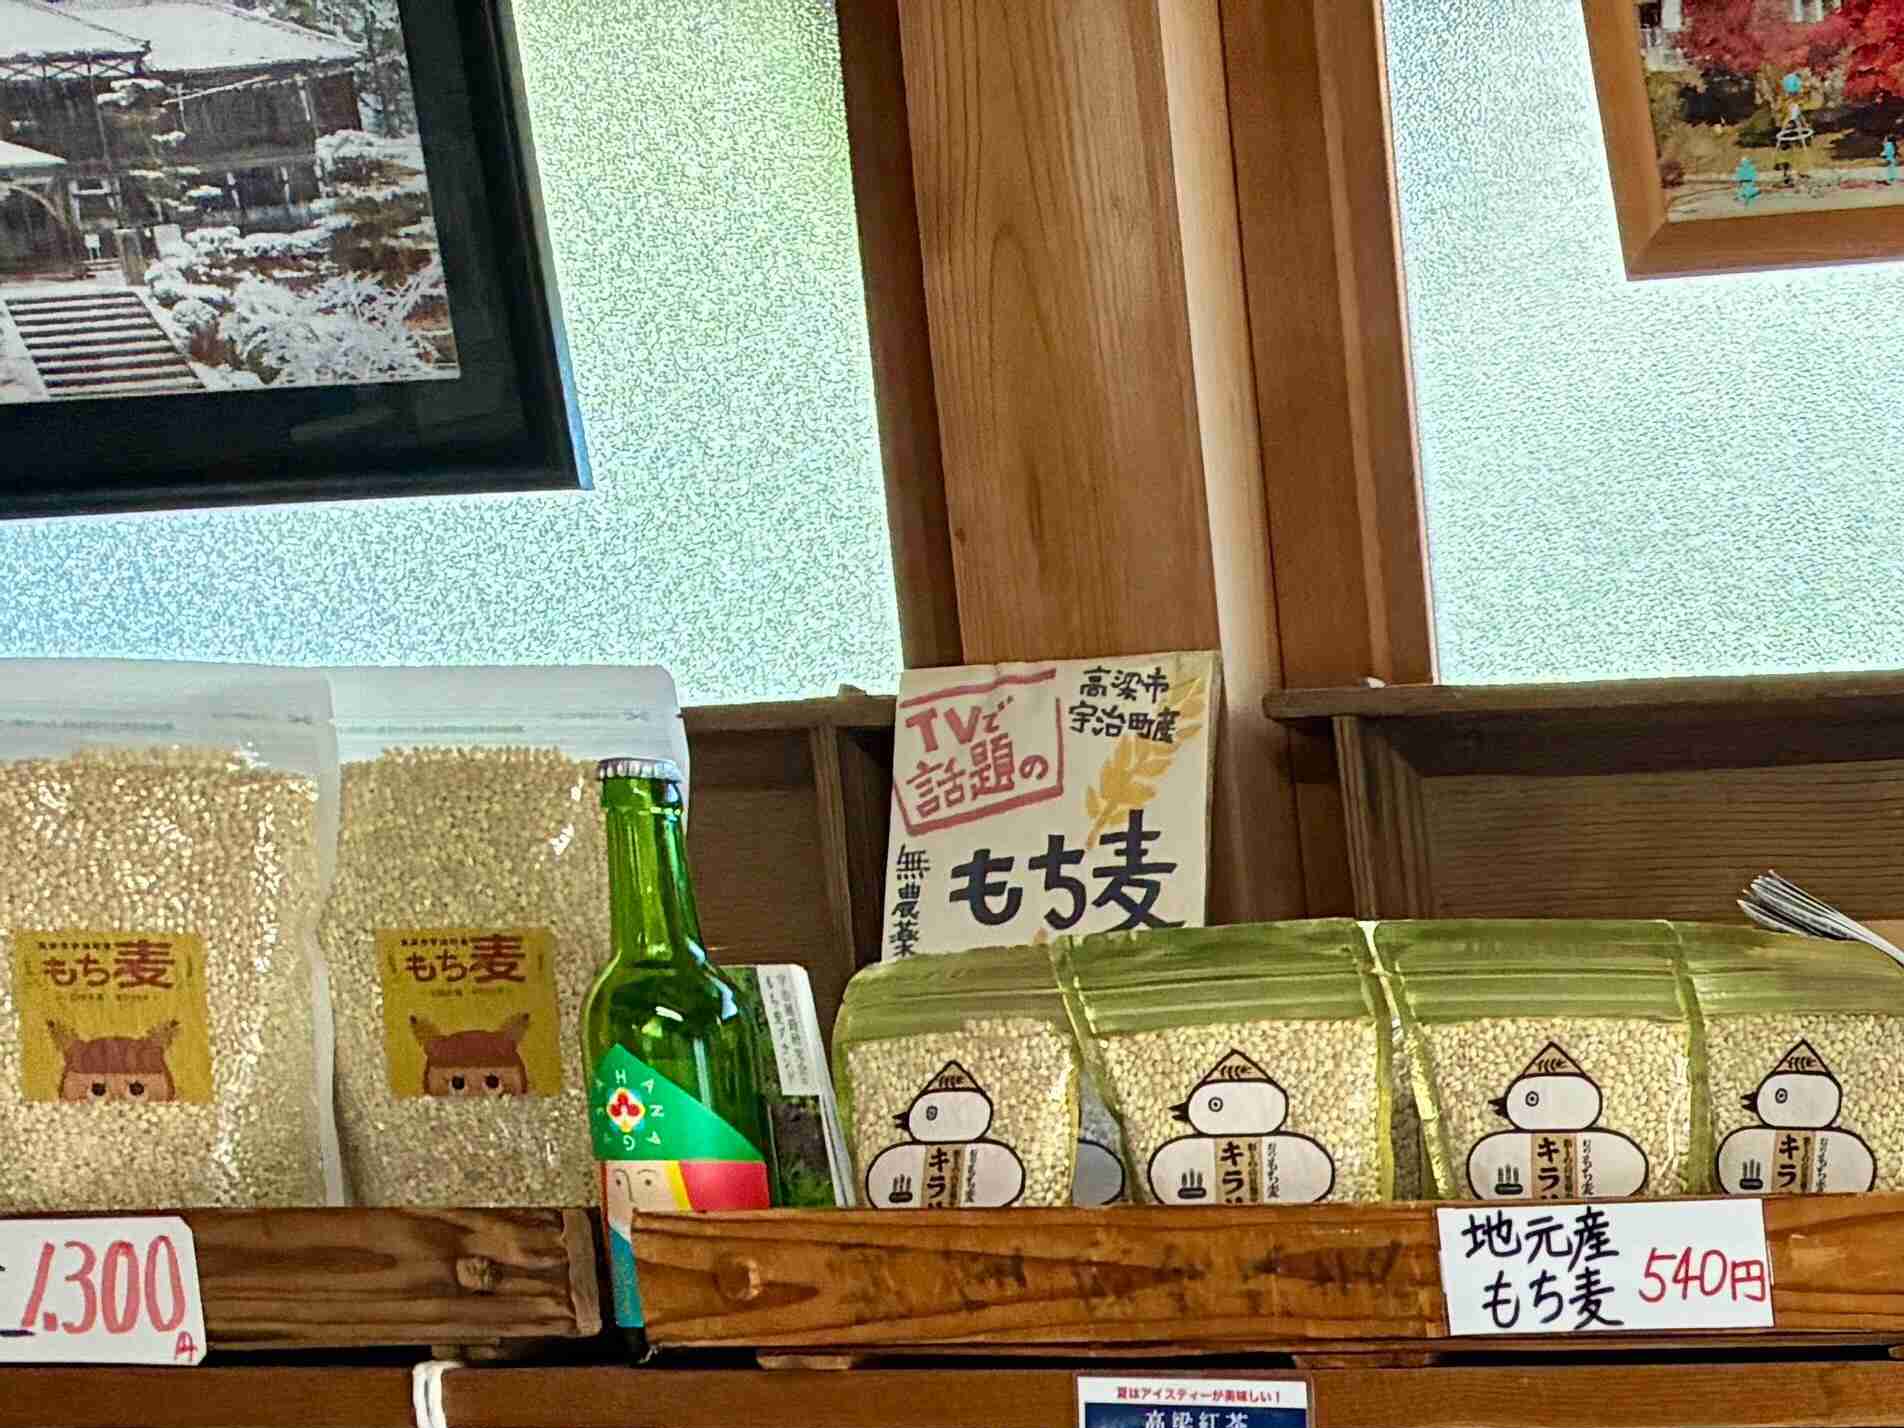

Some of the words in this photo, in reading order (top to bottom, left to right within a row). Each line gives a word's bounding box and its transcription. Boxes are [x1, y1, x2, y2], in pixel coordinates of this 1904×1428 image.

[1080, 666, 1170, 704] 高梁市
[905, 695, 1014, 752] TVで
[1068, 702, 1181, 743] 宇治町産
[906, 733, 1048, 818] 話題の
[949, 809, 1186, 930] もち麦
[890, 843, 931, 958] 無農薬
[42, 939, 175, 989] もち麦
[404, 936, 527, 988] もち麦
[1461, 1206, 1620, 1272] 地元産
[1481, 1266, 1625, 1330] もち麦
[1638, 1247, 1767, 1302] 540円
